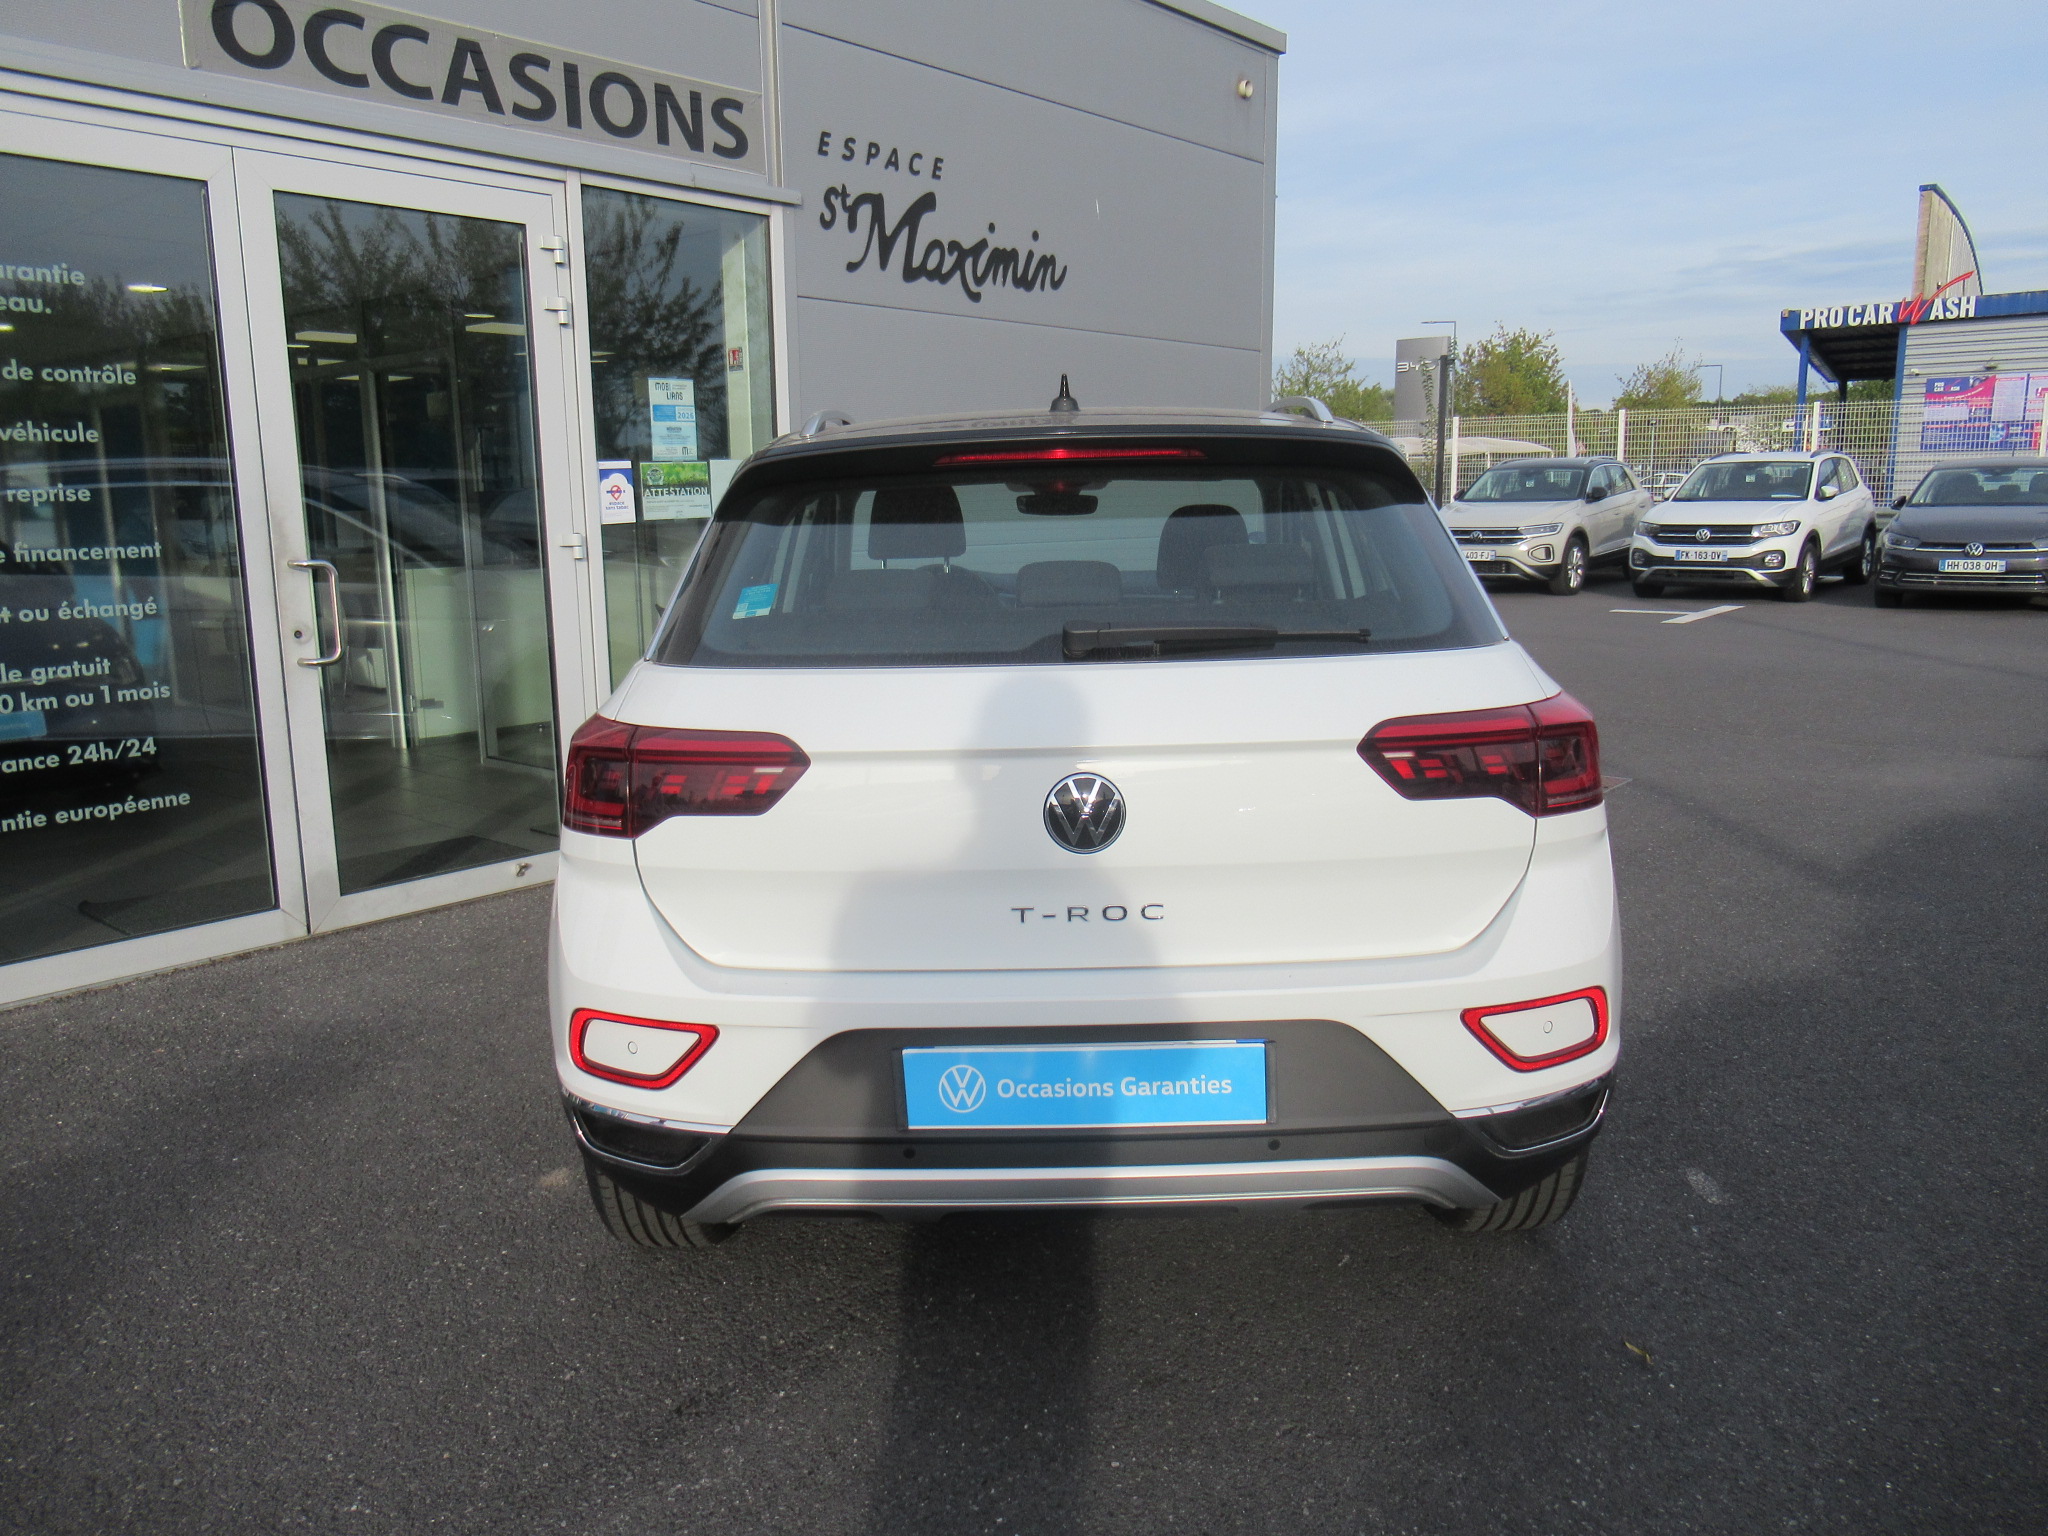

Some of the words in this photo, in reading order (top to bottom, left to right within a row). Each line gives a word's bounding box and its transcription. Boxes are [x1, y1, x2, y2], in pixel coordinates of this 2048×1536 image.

[211, 0, 749, 160] OCCASIONS
[817, 131, 944, 180] ESPACE
[846, 191, 1068, 303] Maximin
[1799, 308, 1844, 330] PRO
[1847, 303, 1894, 327] CAR
[1897, 270, 1976, 326] WASH
[2, 358, 34, 380] de
[41, 364, 137, 385] contrôle
[677, 412, 695, 420] 2026
[0, 420, 99, 442] véhicule
[7, 483, 91, 507] reprise
[644, 487, 708, 497] ATTESTATION
[13, 542, 162, 563] financement
[18, 608, 50, 622] ou
[58, 597, 158, 620] échangé
[0, 662, 23, 683] le
[31, 657, 111, 686] gratuit
[0, 694, 14, 714] 0
[20, 691, 59, 712] km
[65, 694, 94, 708] ou
[101, 685, 112, 704] 1
[117, 682, 171, 702] mois
[0, 754, 60, 774] ance
[67, 737, 157, 766] 24h/24
[0, 810, 47, 833] ntie
[55, 793, 191, 825] européenne
[1010, 903, 1165, 924] T-ROC
[997, 1077, 1114, 1099] Occasions
[1120, 1074, 1233, 1097] Garanties
